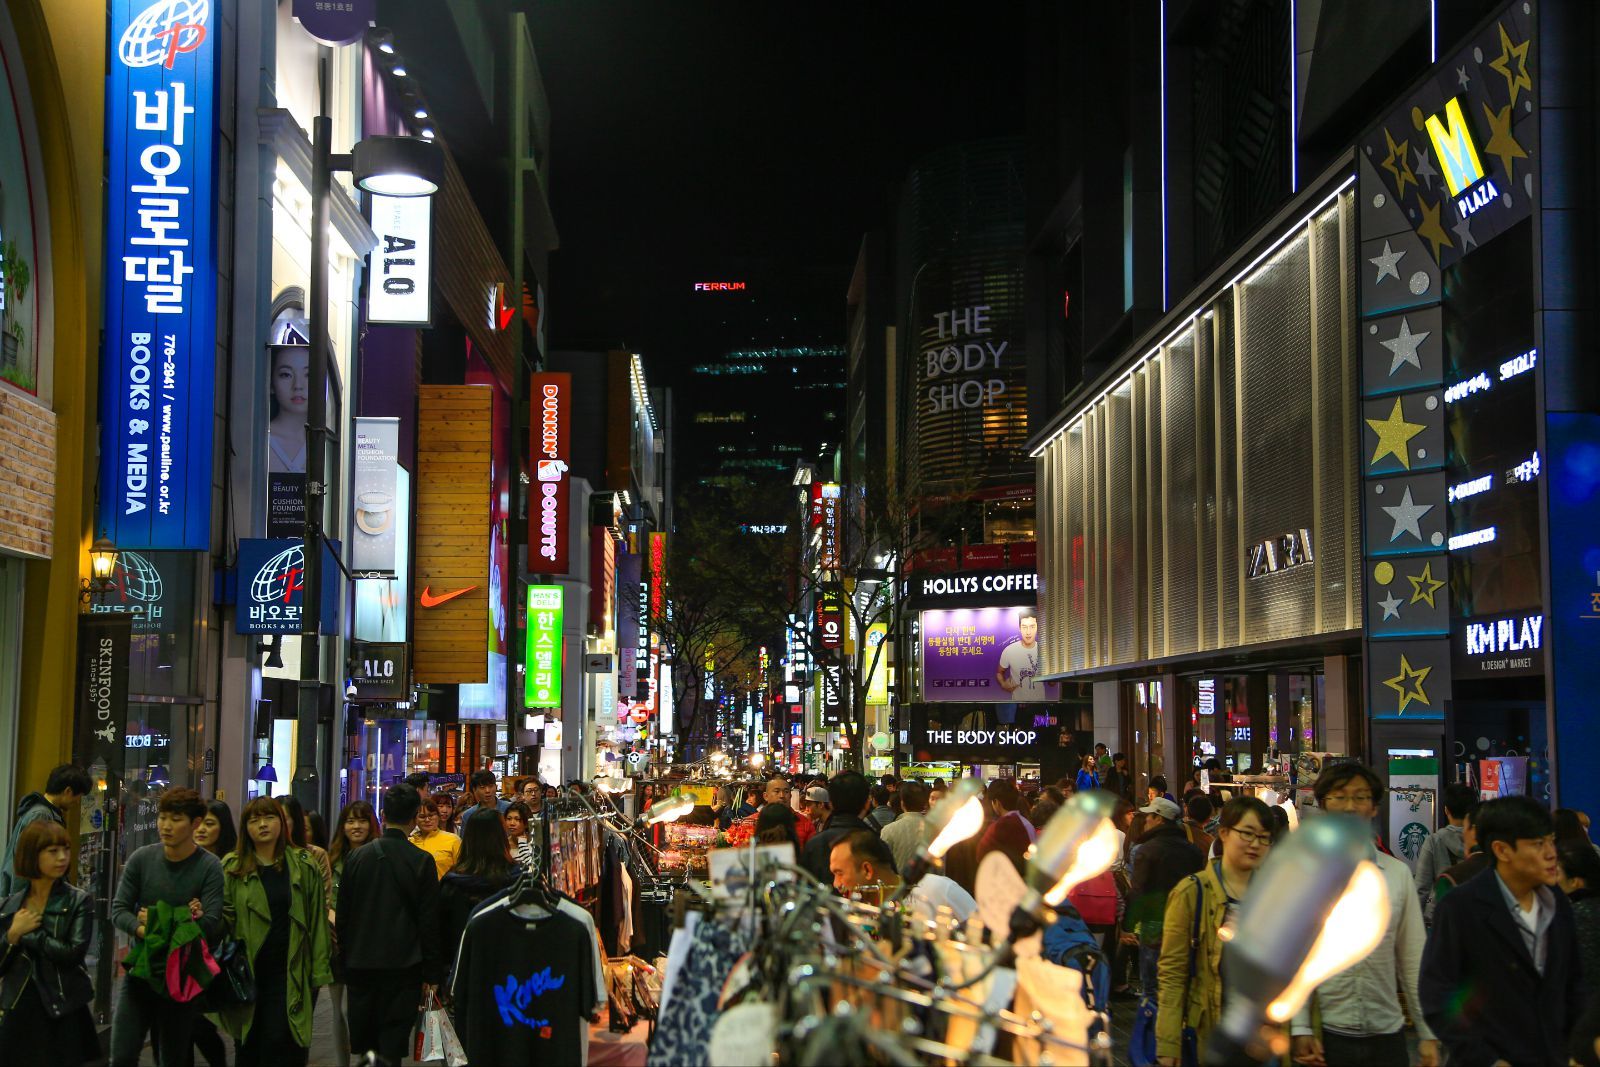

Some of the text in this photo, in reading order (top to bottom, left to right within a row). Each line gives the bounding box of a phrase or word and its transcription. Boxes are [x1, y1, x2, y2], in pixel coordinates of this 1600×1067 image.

[1425, 96, 1485, 198] M
[122, 82, 195, 314] 바오로딸
[1457, 181, 1499, 219] PLAZA
[383, 235, 415, 295] ALO
[694, 282, 745, 291] FERRUM
[933, 305, 992, 339] THE
[926, 341, 1008, 378] BODY
[163, 393, 175, 401] /
[928, 379, 1006, 413] SHOP
[125, 332, 152, 516] BOOKS & MEDIA
[541, 384, 559, 459] DUNKIN'
[159, 404, 173, 515] www.pauline.or.kr
[1246, 528, 1314, 578] ZARA
[360, 571, 388, 579] VDL
[923, 576, 979, 595] HOLLYS
[249, 603, 303, 623] 바오로
[928, 635, 995, 647] 동물실험 반대 서명에
[945, 626, 959, 636] 다시
[1466, 615, 1543, 655] KM PLAY
[535, 611, 555, 689] 한스델리
[938, 647, 959, 657] 동참해
[1510, 657, 1532, 669] MARKET
[89, 684, 98, 702] 1957
[97, 638, 113, 721] SKINFOOD
[926, 730, 1036, 745] THE BODY SHOP
[493, 966, 566, 1028] Korea
